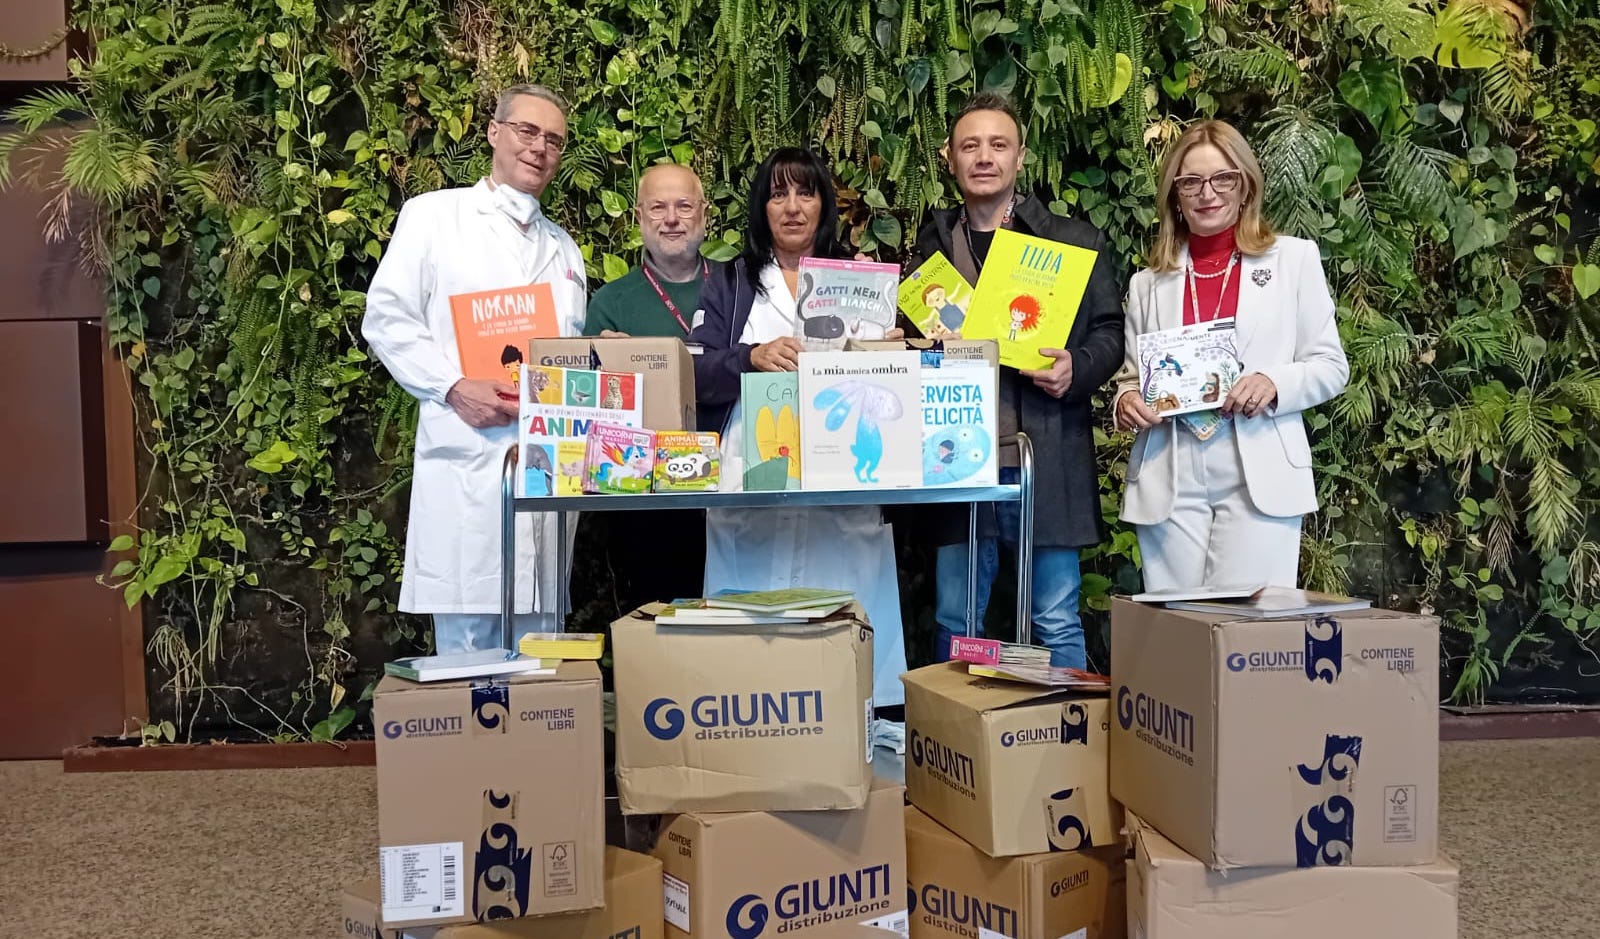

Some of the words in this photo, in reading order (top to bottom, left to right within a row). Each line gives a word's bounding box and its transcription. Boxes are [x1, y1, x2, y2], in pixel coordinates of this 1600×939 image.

[1019, 244, 1063, 275] TILDA
[815, 286, 848, 296] GATTI
[852, 286, 881, 300] NERI
[471, 293, 536, 324] NORMAN
[807, 298, 837, 309] GATTI
[840, 297, 885, 313] BIANCHI
[630, 354, 668, 363] CONTIENE
[946, 346, 983, 355] CONTIENE
[649, 362, 668, 370] LIBRI
[812, 367, 822, 376] La
[824, 365, 845, 376] mia
[846, 367, 870, 375] amica
[871, 363, 908, 375] ombra
[921, 384, 983, 404] RVISTA
[921, 403, 984, 426] ELICITÀ
[1248, 651, 1304, 667] GIUNTI
[1360, 647, 1415, 659] CONTIENE
[1387, 660, 1415, 671] LIBRI
[520, 708, 575, 722] CONTIENE
[690, 690, 823, 728] GIUNTI
[404, 716, 462, 734] GIUNTI
[547, 719, 575, 731] LIBRI
[1135, 692, 1194, 753] GIUNTI
[694, 725, 824, 741] distribuzione
[1016, 727, 1059, 742] GIUNTI
[1135, 729, 1194, 767] distribuzione
[924, 736, 975, 789] GIUNTI
[927, 766, 977, 801] distribuzione
[668, 831, 692, 848] CONTIENE
[1060, 869, 1089, 890] GIUNTI
[774, 863, 890, 920] GIUNTI
[776, 899, 890, 935] distribuzione
[921, 883, 1018, 939] GIUNTI
[923, 914, 980, 939] distribu
